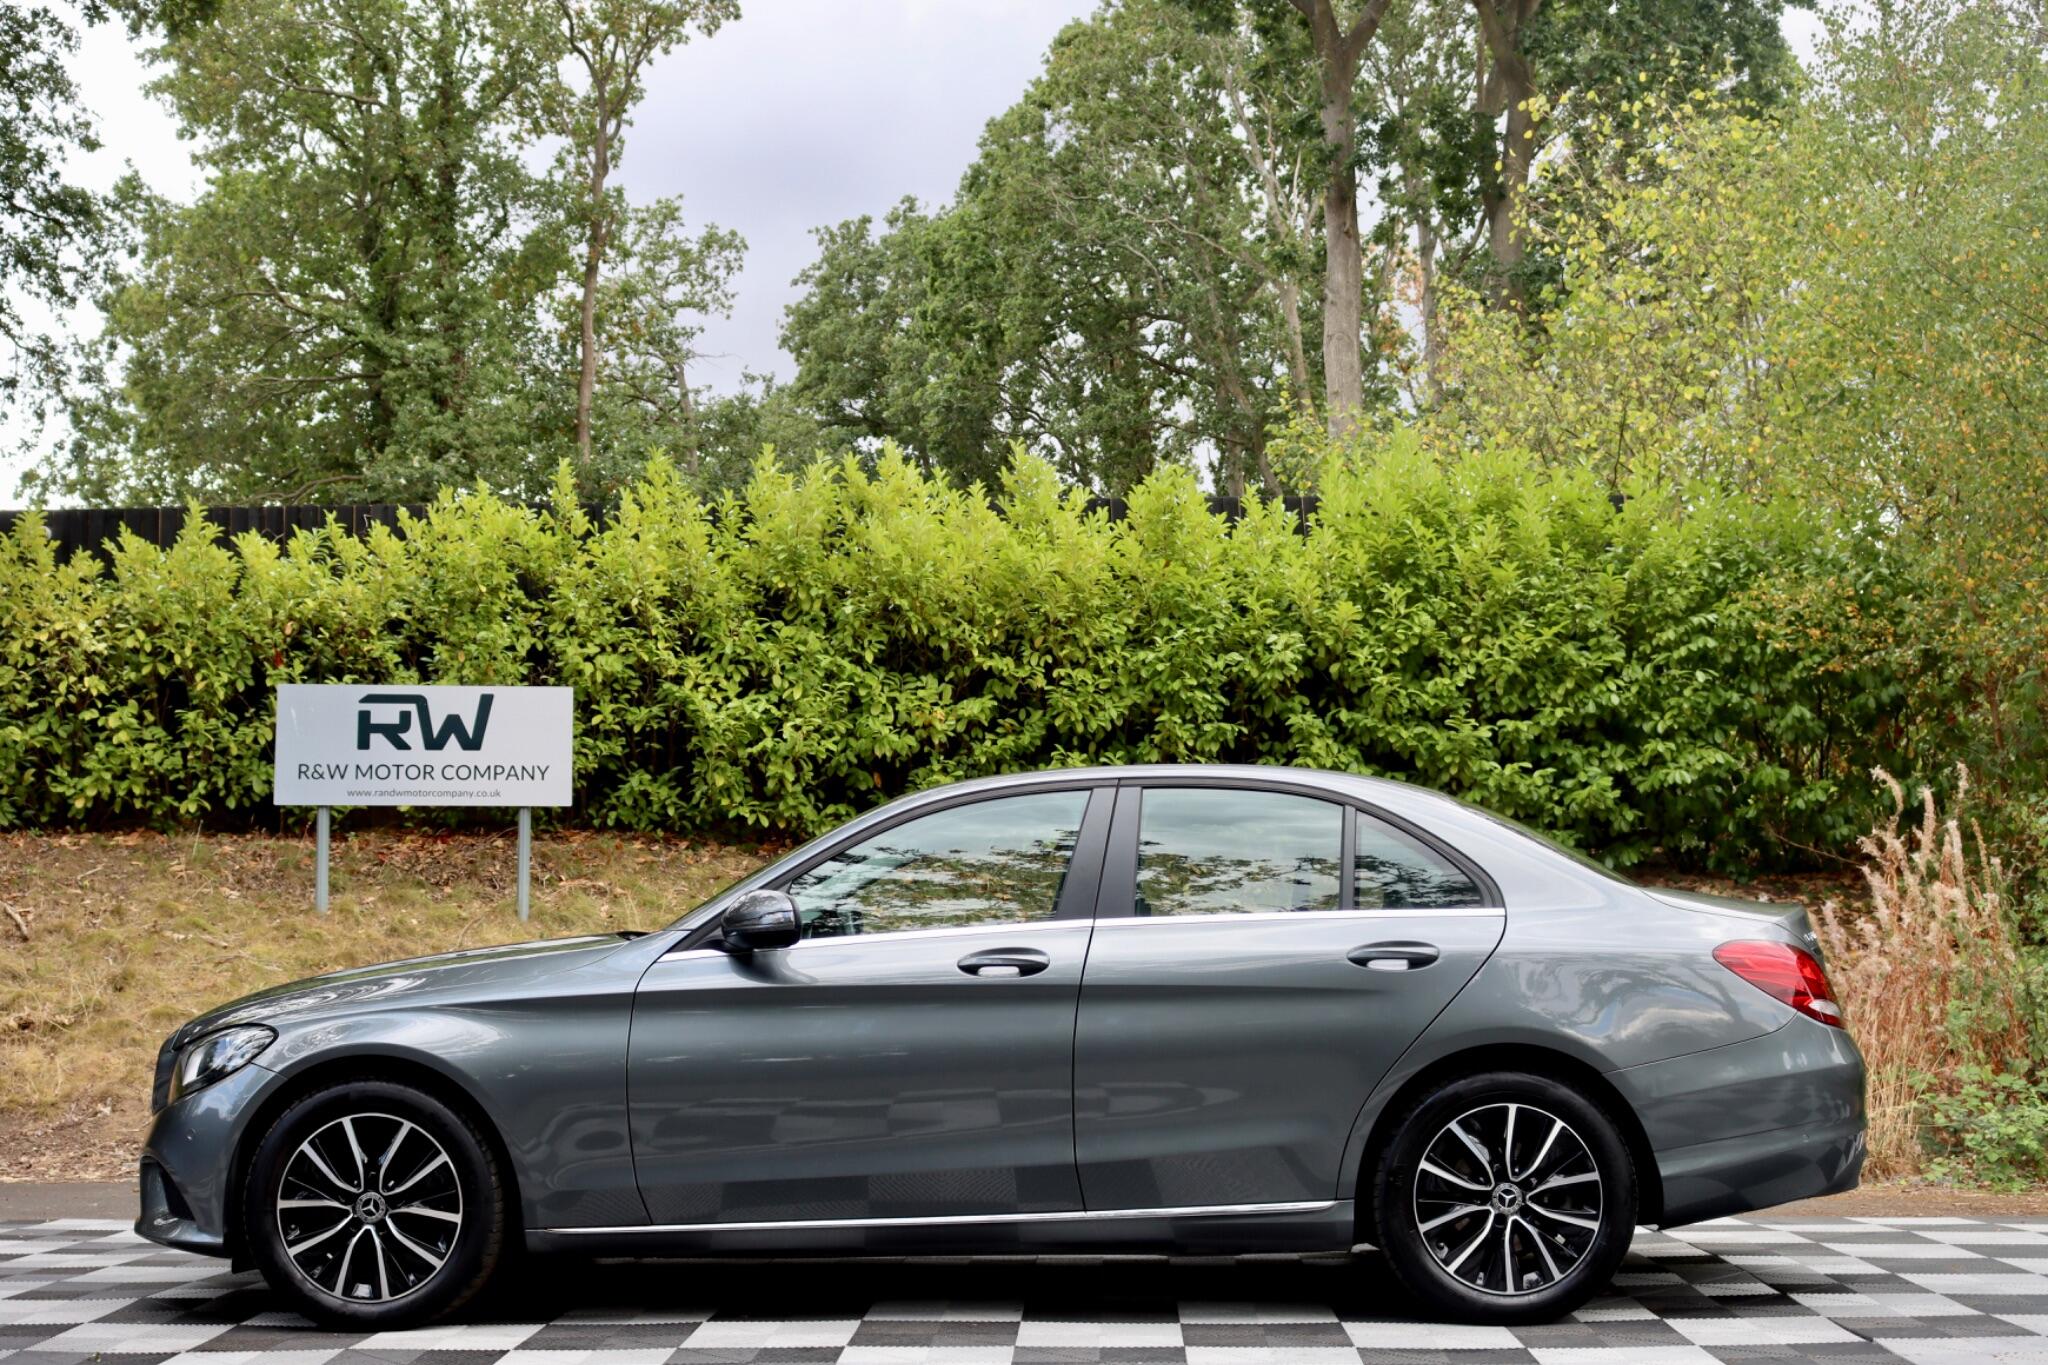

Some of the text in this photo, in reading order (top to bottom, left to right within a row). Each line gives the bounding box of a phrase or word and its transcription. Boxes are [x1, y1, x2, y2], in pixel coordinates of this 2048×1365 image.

[357, 694, 494, 751] RW
[298, 763, 550, 781] R&W MOTOR COMPANY
[346, 788, 502, 800] www.randwmotorcompany.co.uk
